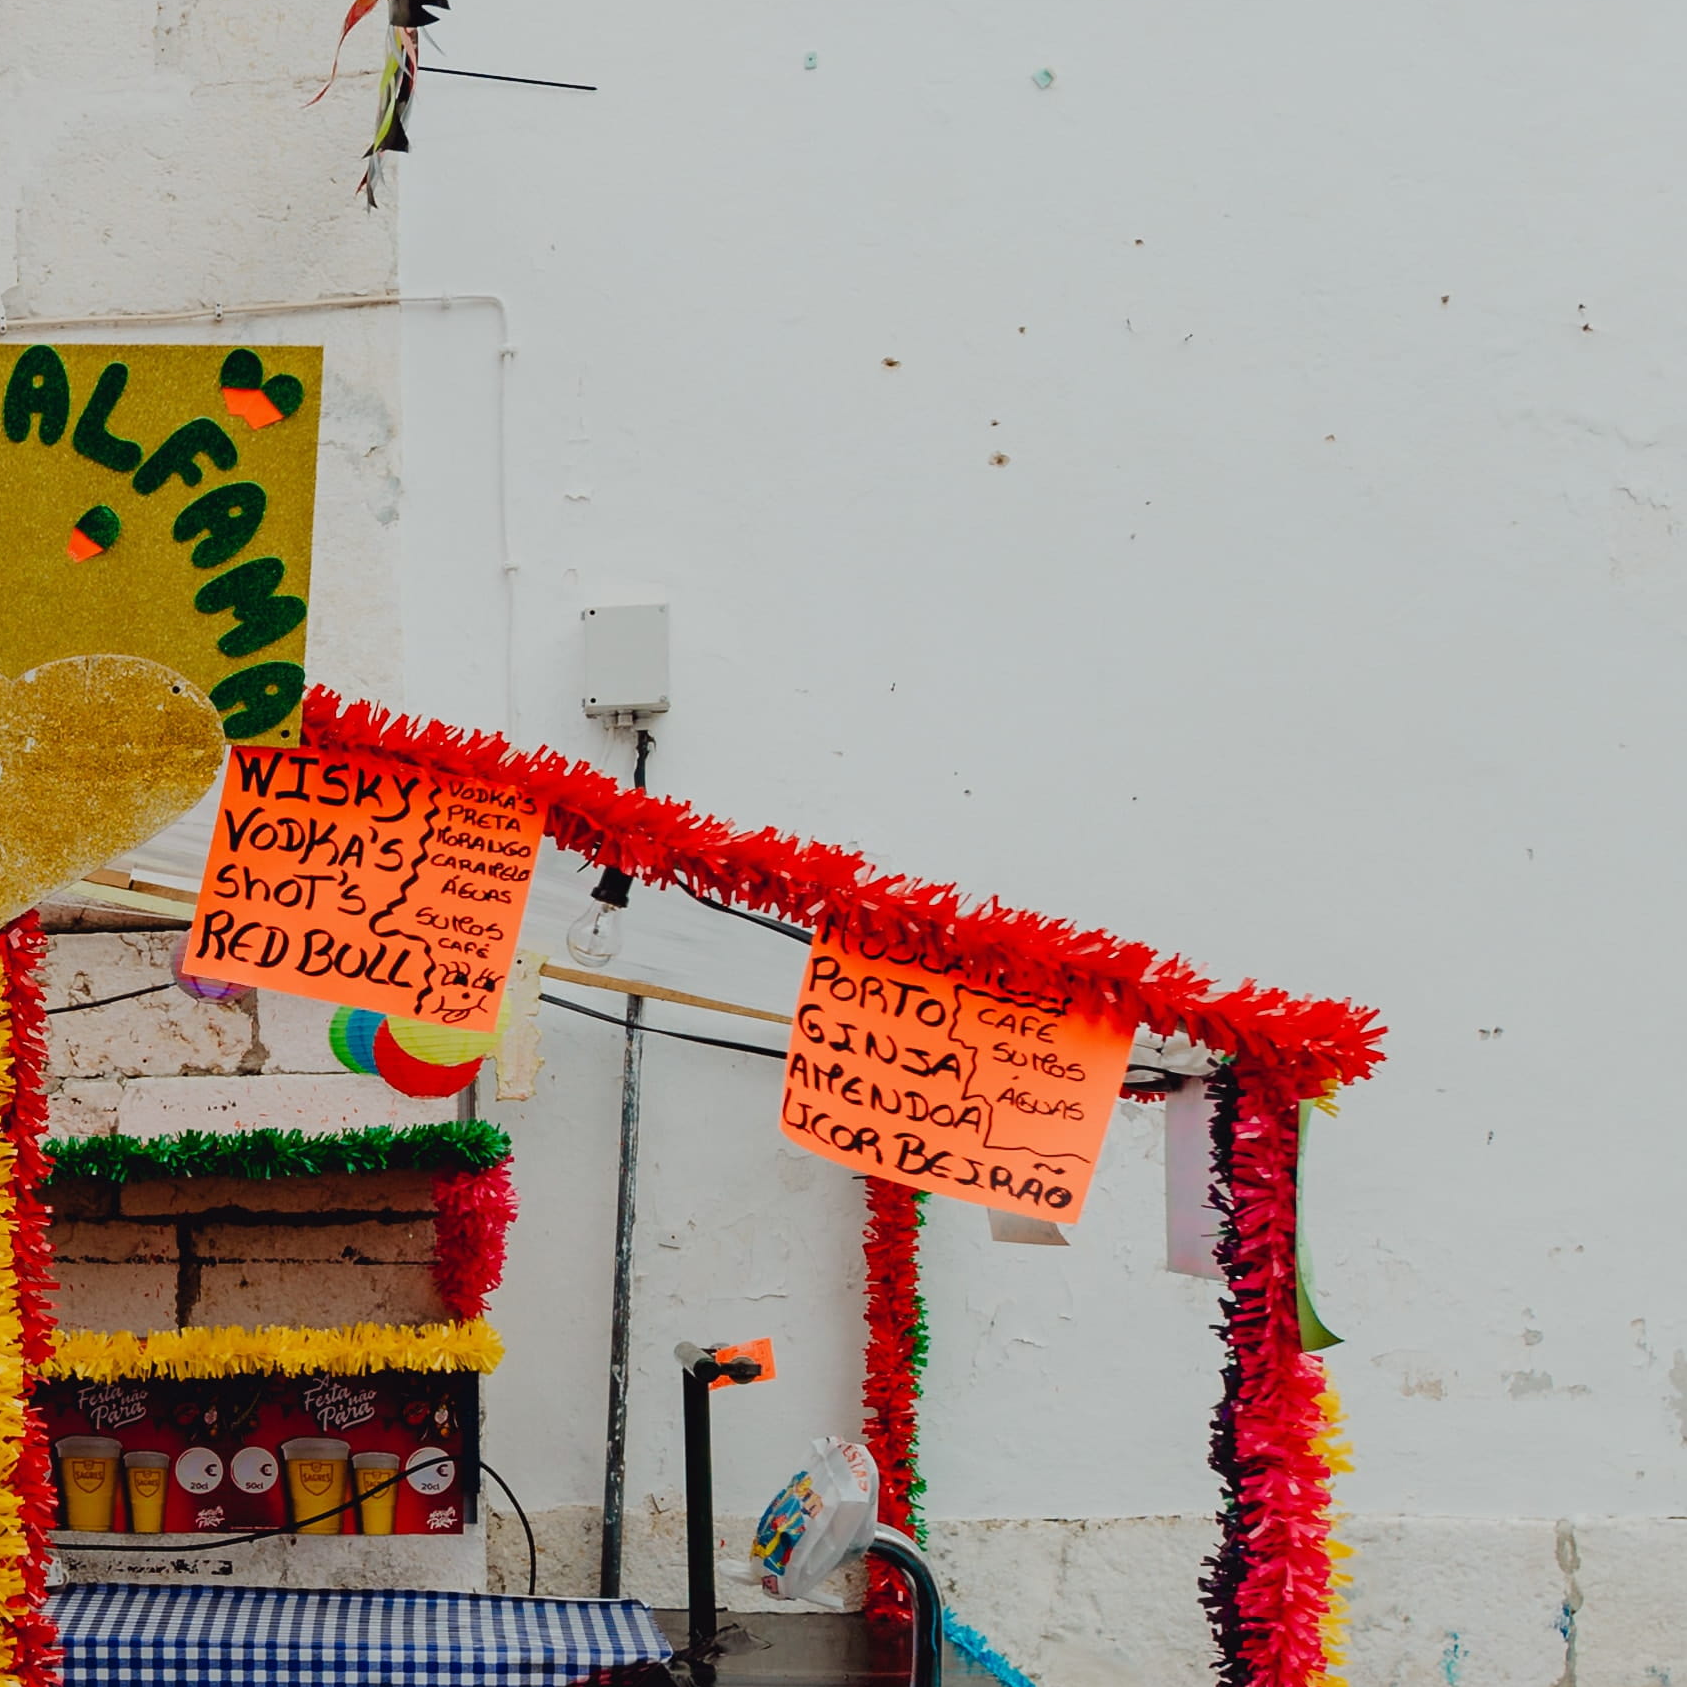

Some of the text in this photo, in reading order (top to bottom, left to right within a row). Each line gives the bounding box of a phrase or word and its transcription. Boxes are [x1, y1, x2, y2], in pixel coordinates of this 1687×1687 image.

[234, 750, 419, 823] WISKY
[446, 804, 522, 833] PRETA
[435, 826, 532, 859] MORANGO
[195, 909, 414, 989] RED BULL
[808, 955, 947, 1028] PORTO
[797, 1003, 962, 1082] GINJA
[789, 1052, 983, 1134] AMENDOA
[303, 1384, 351, 1412] Festa
